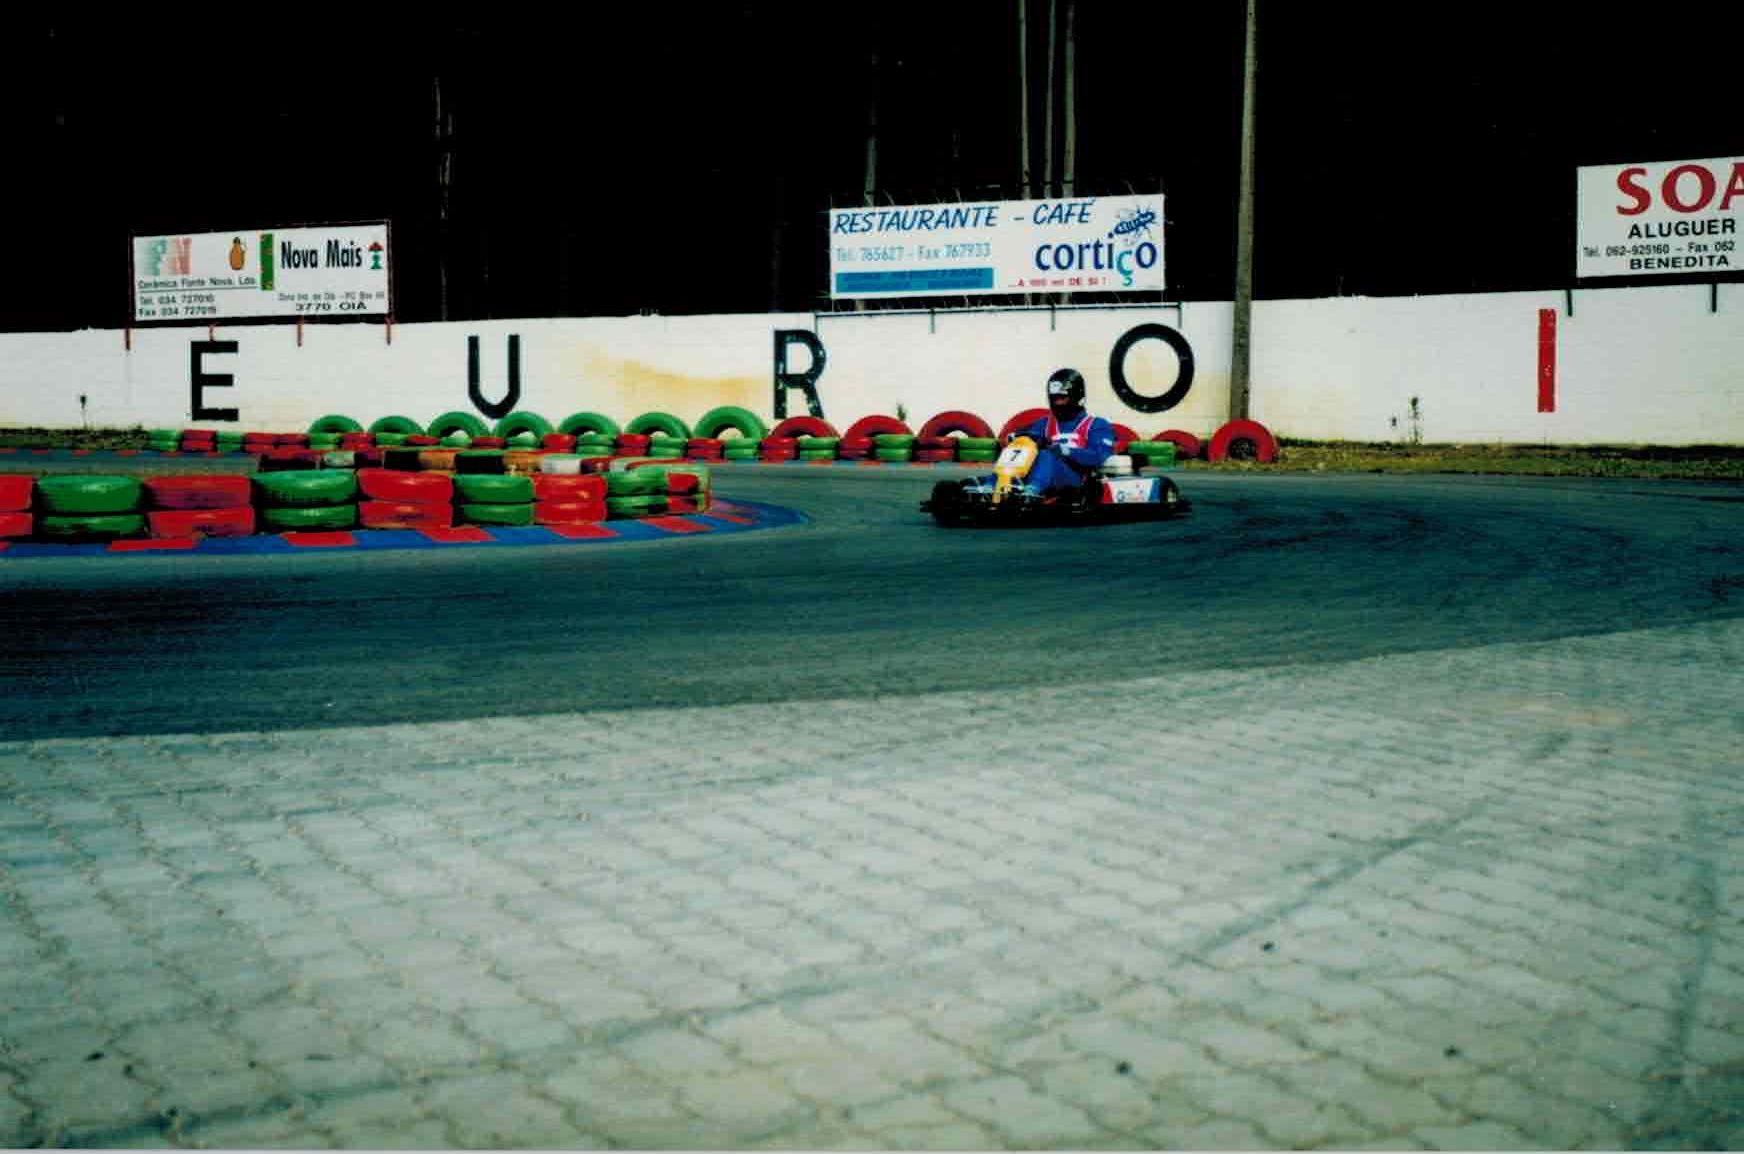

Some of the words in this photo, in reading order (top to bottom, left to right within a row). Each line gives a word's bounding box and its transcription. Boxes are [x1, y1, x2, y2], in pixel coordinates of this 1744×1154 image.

[834, 205, 999, 234] RESTAURANTE
[1032, 198, 1096, 225] CAFÉ
[1628, 218, 1736, 239] ALUGUER
[281, 241, 318, 269] Nova
[326, 239, 362, 268] Mais
[1688, 242, 1709, 254] Fax
[1035, 232, 1158, 287] cortiço
[1630, 255, 1729, 270] BENEDITA
[1010, 449, 1021, 463] 7
